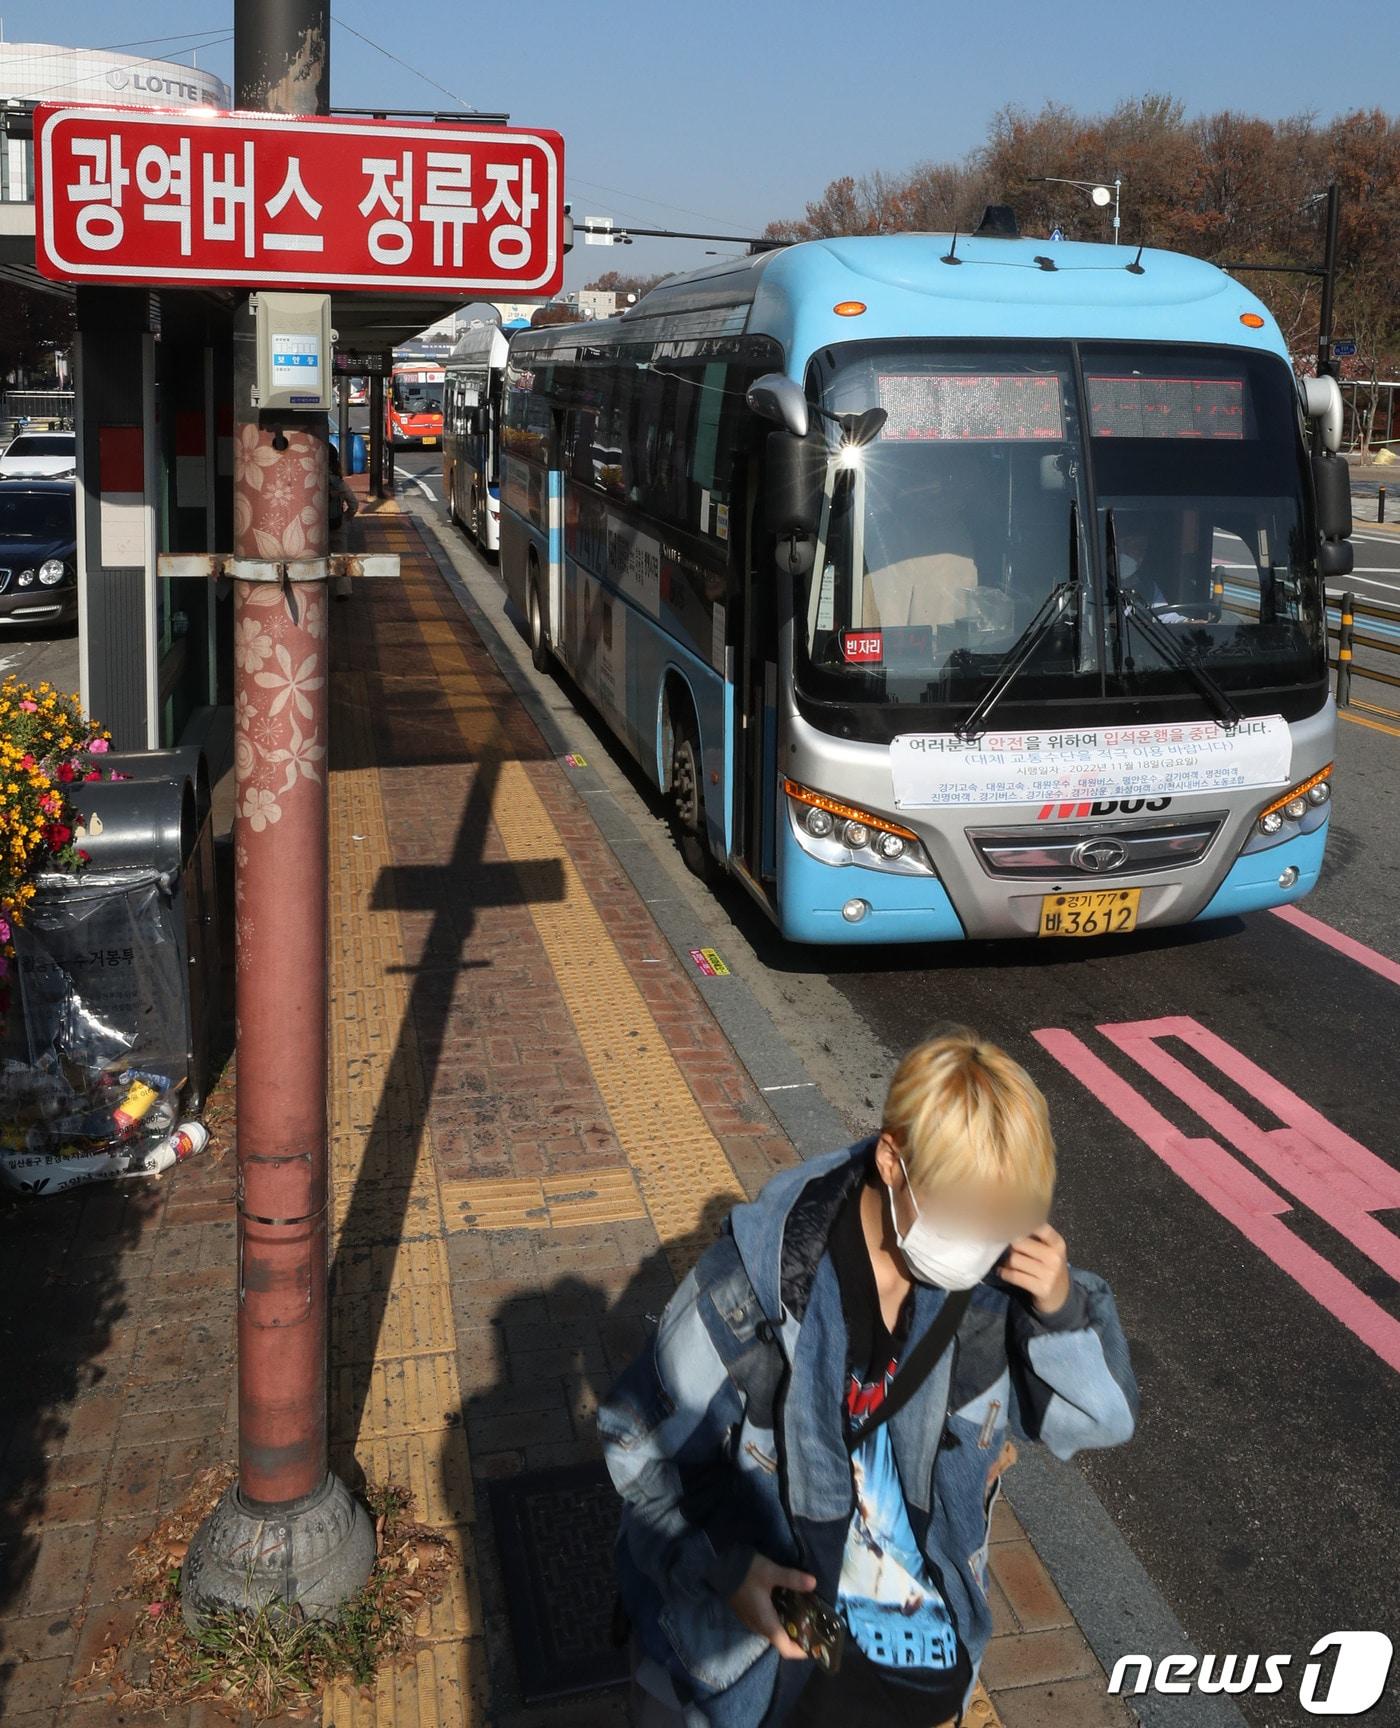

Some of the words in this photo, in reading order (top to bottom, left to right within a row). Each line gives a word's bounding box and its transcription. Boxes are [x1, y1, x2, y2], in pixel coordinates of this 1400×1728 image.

[134, 74, 198, 101] LOTTE
[67, 134, 324, 258] 광역버스
[358, 151, 539, 269] 정류장
[846, 639, 881, 655] 빈자리
[909, 737, 982, 752] 여러분의
[988, 735, 1042, 751] 안전을
[1047, 733, 1098, 749] 위하여
[1104, 727, 1185, 746] 입석운행을
[1011, 750, 1092, 764] 교통수단을
[1098, 748, 1129, 760] 적극
[1133, 745, 1163, 758] 이용
[1069, 763, 1108, 774] 2022년
[1111, 761, 1134, 771] 11월
[1067, 895, 1092, 908] 경기
[1096, 893, 1118, 907] 77
[1045, 907, 1132, 934] 바3612
